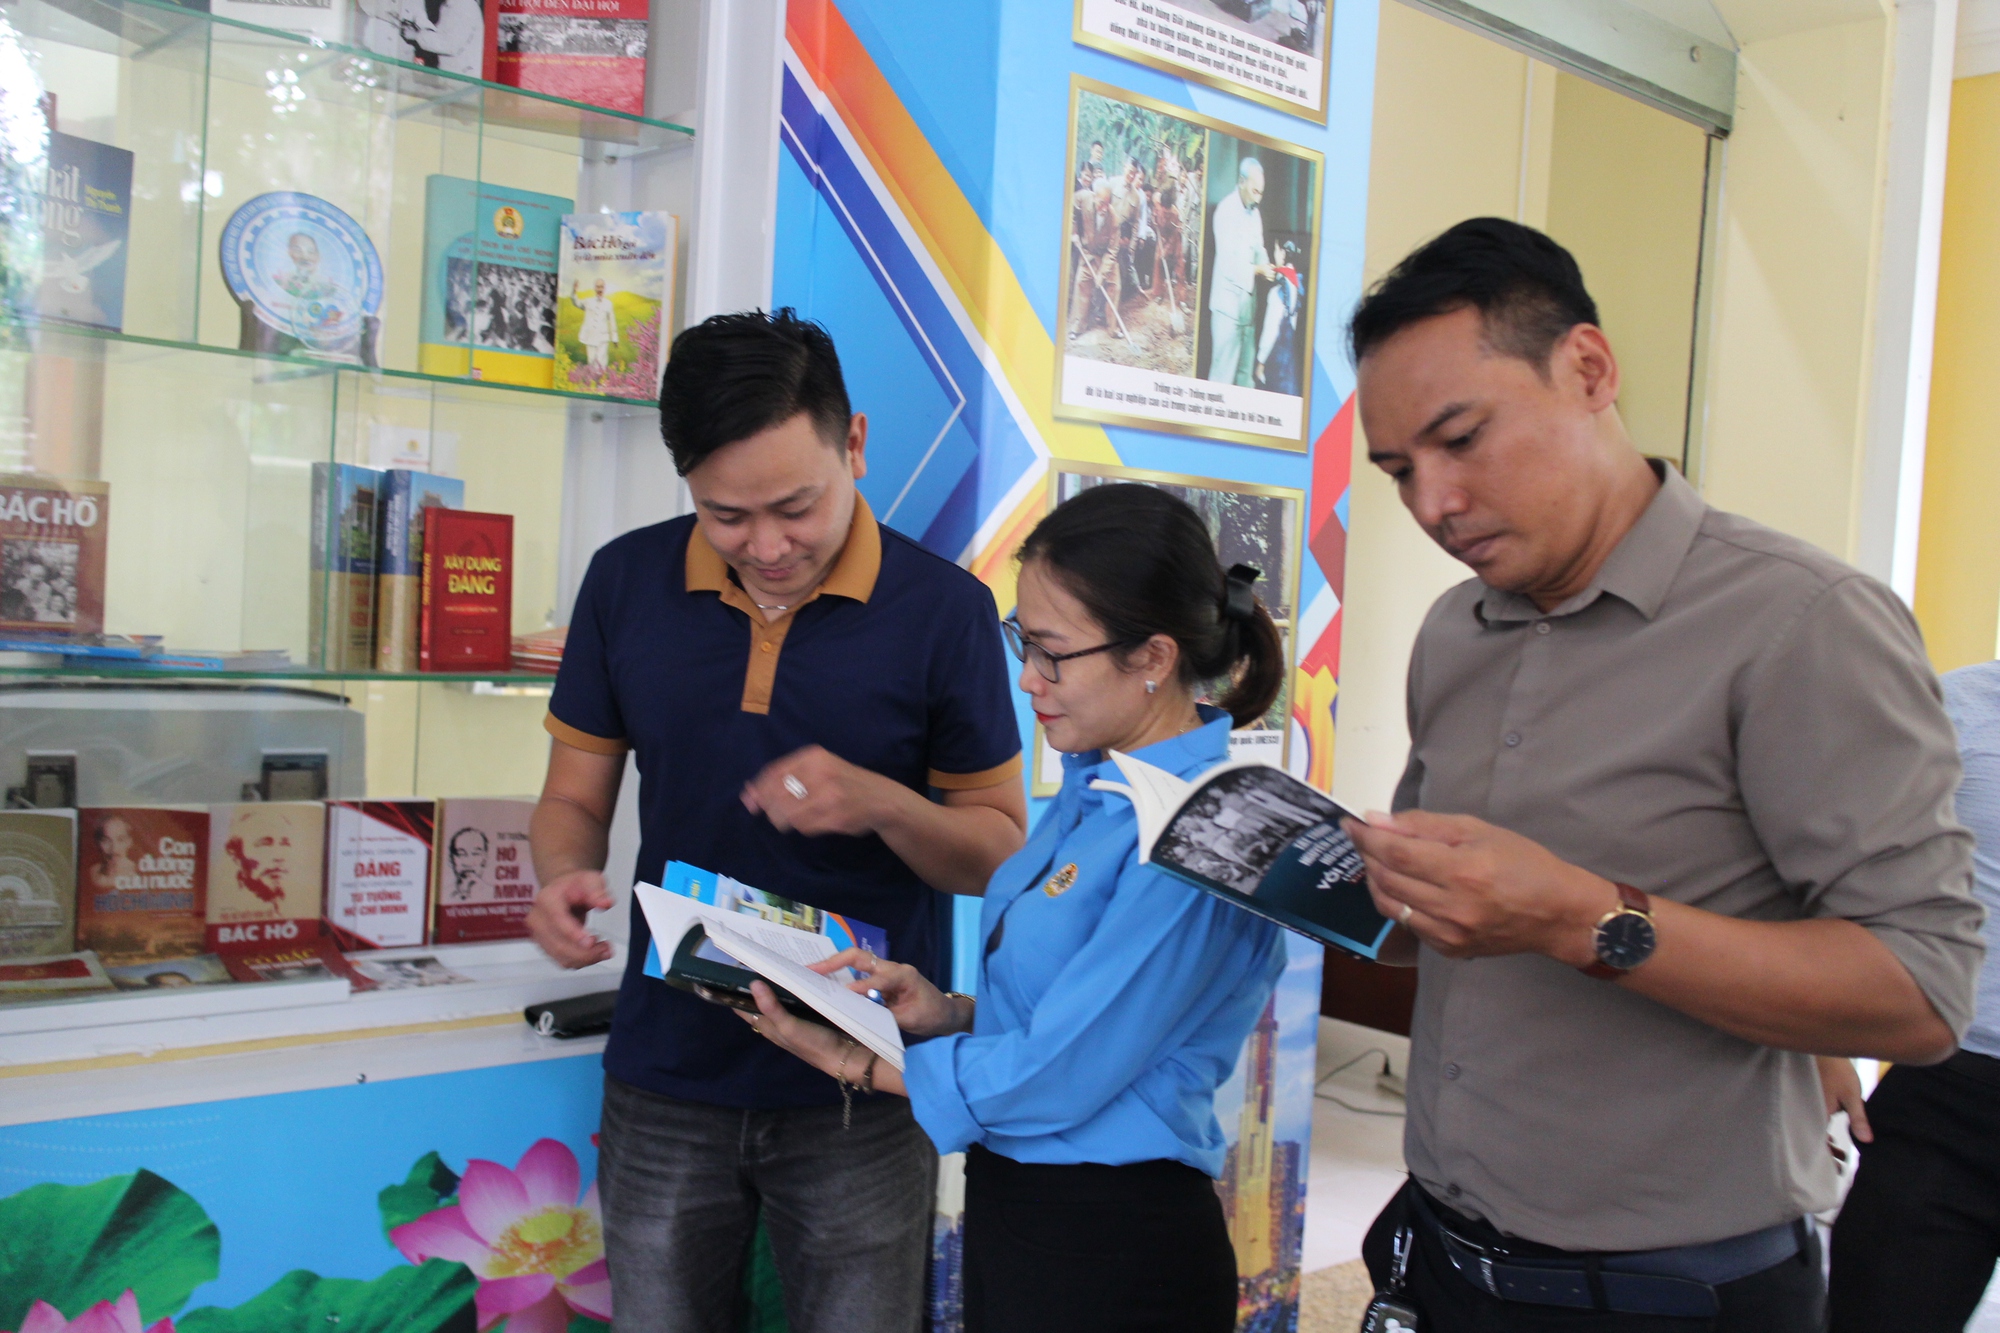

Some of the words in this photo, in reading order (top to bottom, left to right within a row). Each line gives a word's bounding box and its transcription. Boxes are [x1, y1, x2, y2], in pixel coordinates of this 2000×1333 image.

[52, 495, 98, 527] HỒ
[443, 553, 464, 570] XÂY
[464, 555, 502, 573] DỰNG
[447, 568, 495, 595] ĐẢNG
[159, 836, 196, 855] Con
[496, 843, 517, 862] HỒ
[138, 853, 195, 875] đường
[354, 858, 402, 878] ĐẢNG
[115, 873, 149, 891] cứu
[149, 872, 194, 890] nước
[493, 884, 534, 899] MINH
[217, 923, 260, 944] BÁC
[264, 919, 299, 940] HỒ
